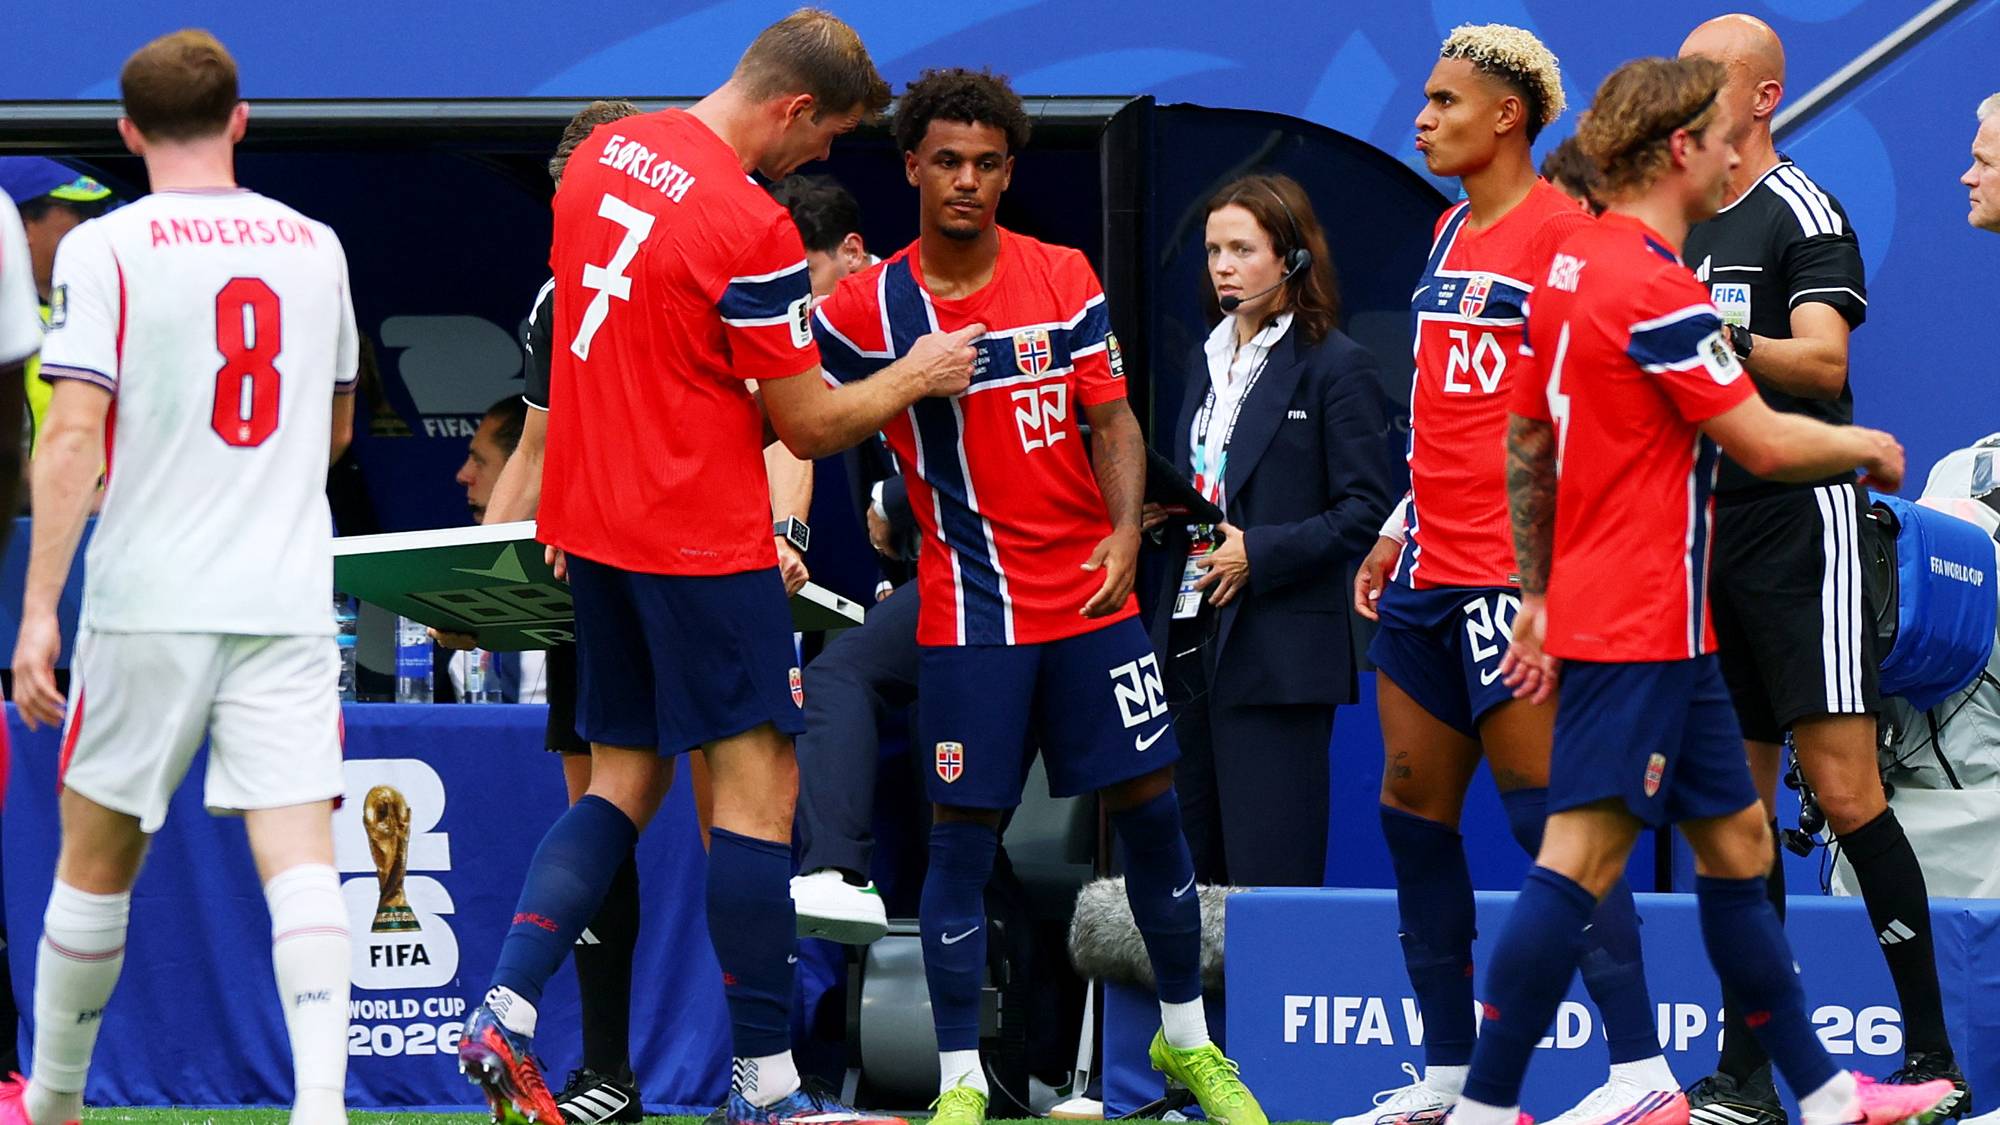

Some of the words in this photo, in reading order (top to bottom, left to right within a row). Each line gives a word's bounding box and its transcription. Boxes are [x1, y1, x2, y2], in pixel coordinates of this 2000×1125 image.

[149, 218, 316, 247] ANDERSON
[570, 193, 656, 362] 7
[1714, 288, 1746, 303] FIFA
[211, 277, 282, 447] 8
[1444, 328, 1507, 394] 20
[422, 418, 476, 438] FIFA
[1010, 383, 1067, 455] 22
[1287, 410, 1308, 420] FIFA
[1463, 593, 1523, 663] 20
[1109, 652, 1169, 729] 22
[370, 944, 431, 967] FIFA
[349, 999, 420, 1020] WORLD
[423, 997, 466, 1018] CUP
[1284, 995, 1394, 1045] FIFA
[348, 1022, 464, 1056] 2026
